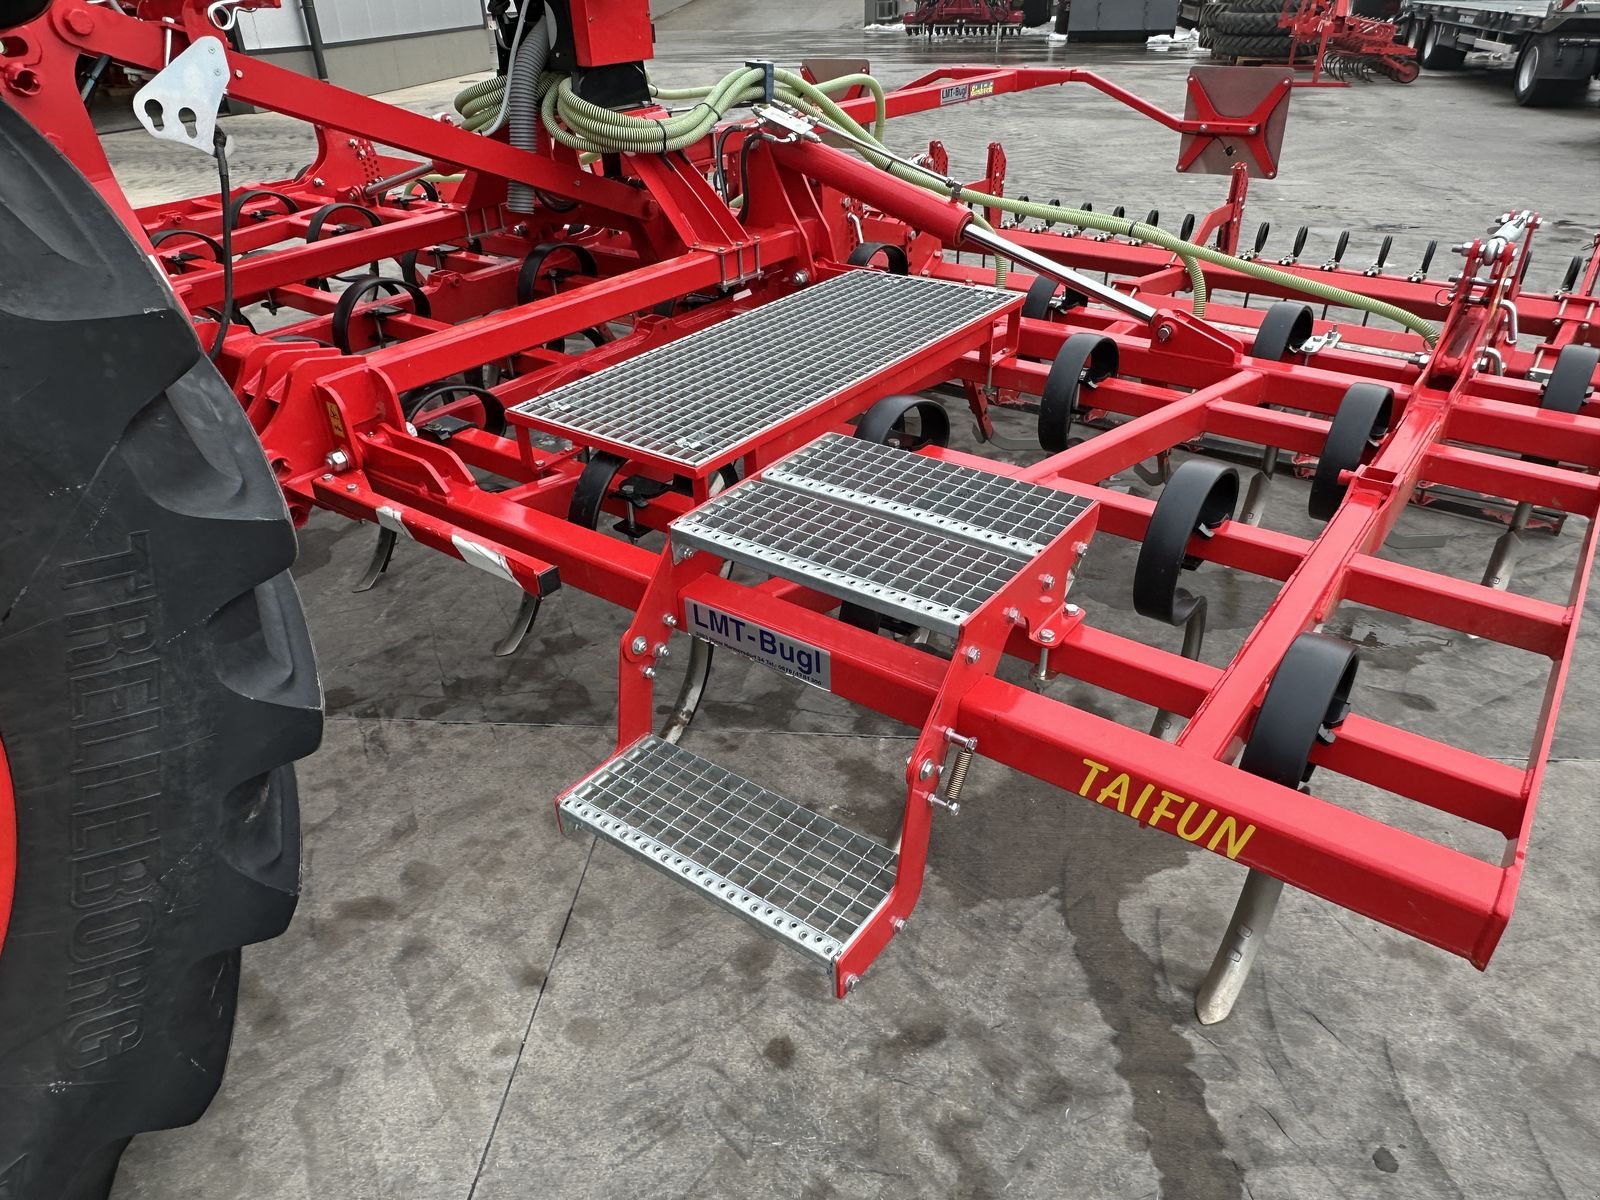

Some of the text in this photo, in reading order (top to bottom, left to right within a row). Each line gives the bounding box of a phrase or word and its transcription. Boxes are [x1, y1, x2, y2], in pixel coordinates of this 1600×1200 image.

[693, 603, 821, 675] LMT-Bugl
[61, 529, 161, 1070] TRELLEBORG
[1079, 758, 1256, 860] TAIFUN
